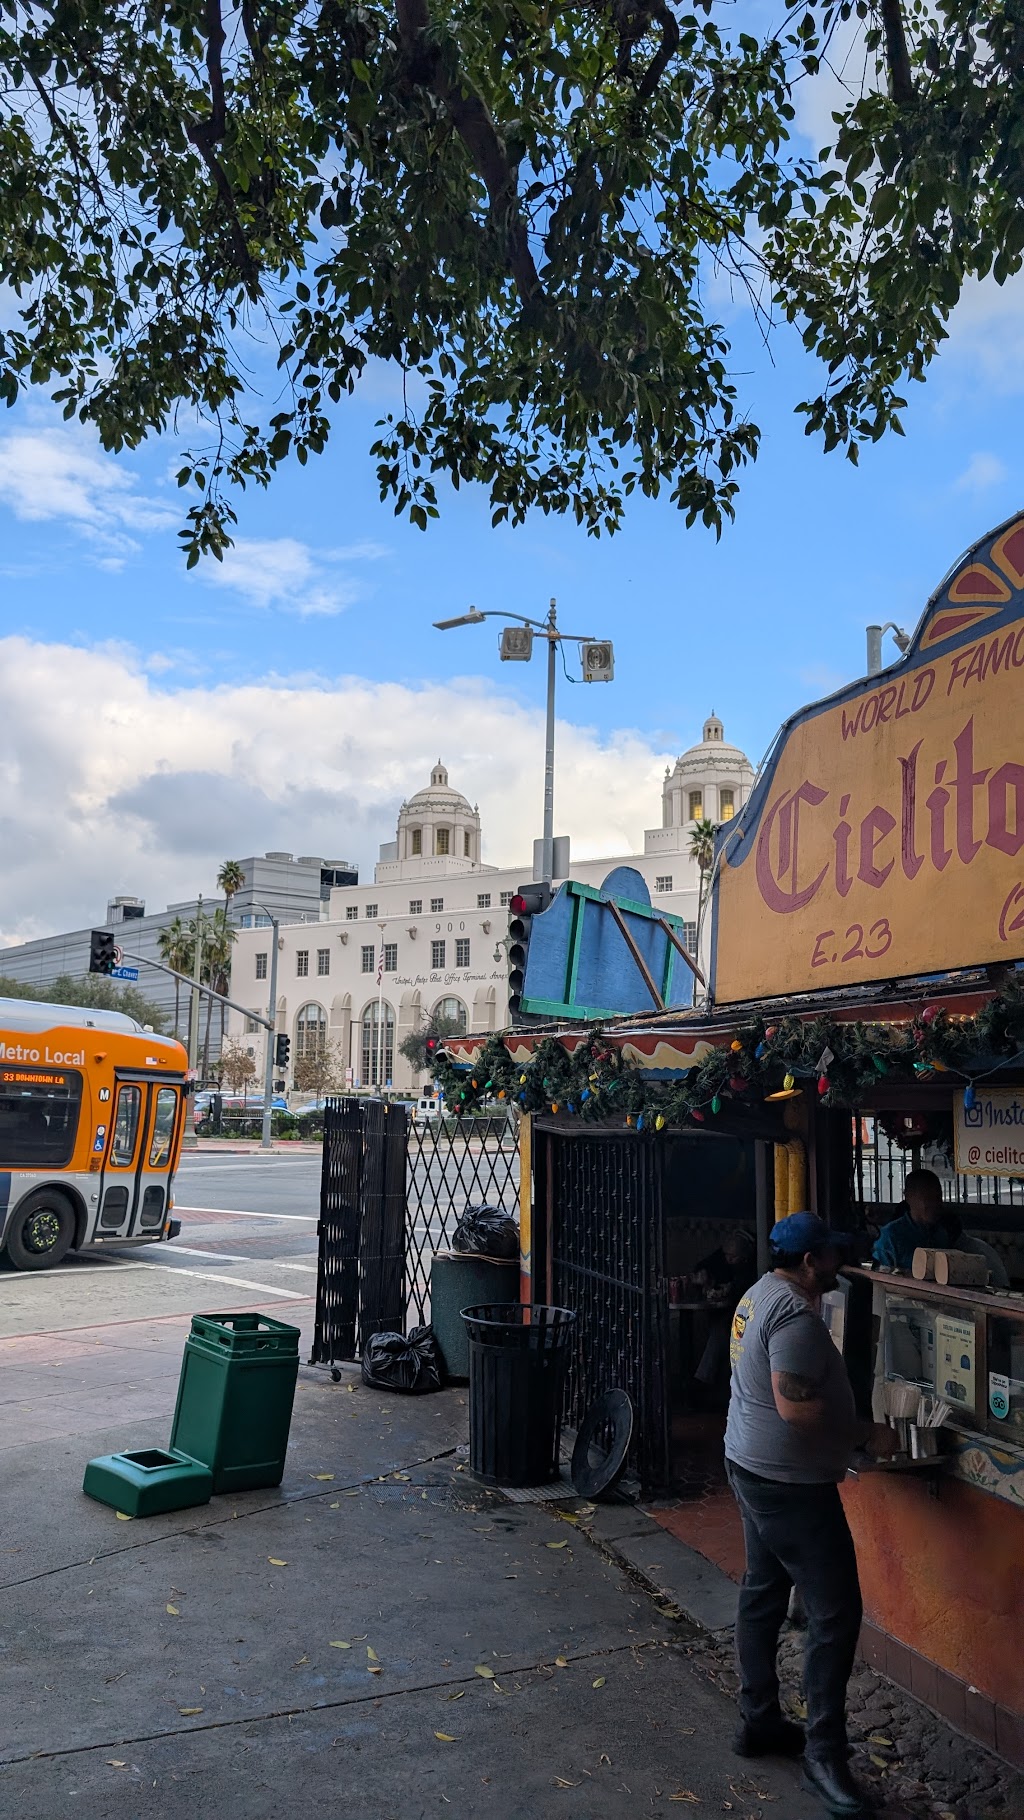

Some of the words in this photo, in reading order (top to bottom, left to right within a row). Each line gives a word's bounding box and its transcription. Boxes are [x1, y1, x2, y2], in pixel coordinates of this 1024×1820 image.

[841, 668, 936, 741] WORLD
[755, 714, 1024, 914] Cielito
[435, 921, 466, 934] 900
[811, 918, 893, 968] E.23
[45, 1046, 85, 1066] Local
[3, 1072, 14, 1082] 33
[15, 1073, 53, 1084] DOWNTOWN
[54, 1076, 65, 1085] LA
[968, 1146, 981, 1165] @
